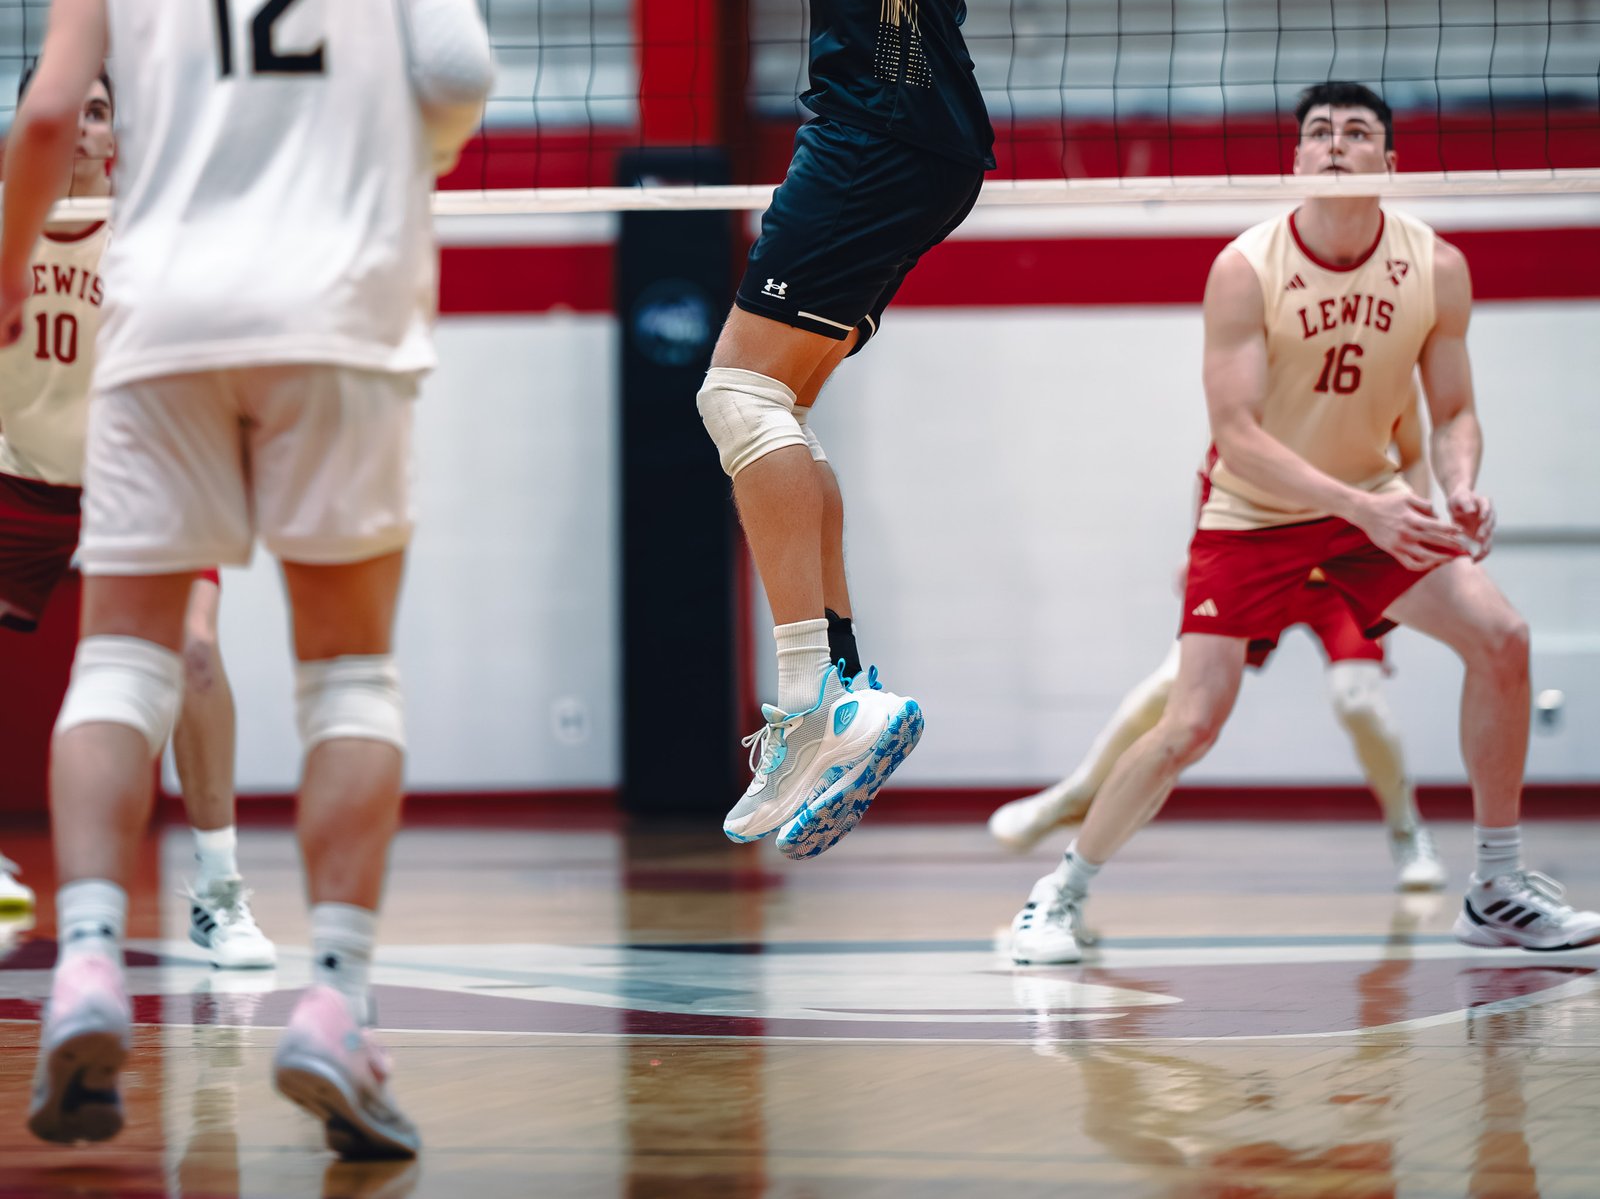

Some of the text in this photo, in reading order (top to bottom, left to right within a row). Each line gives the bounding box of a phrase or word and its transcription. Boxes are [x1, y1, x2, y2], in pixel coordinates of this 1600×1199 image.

[32, 264, 105, 308] EWIS
[34, 311, 78, 366] 10
[1297, 294, 1395, 341] LEWIS
[1312, 343, 1364, 395] 16
